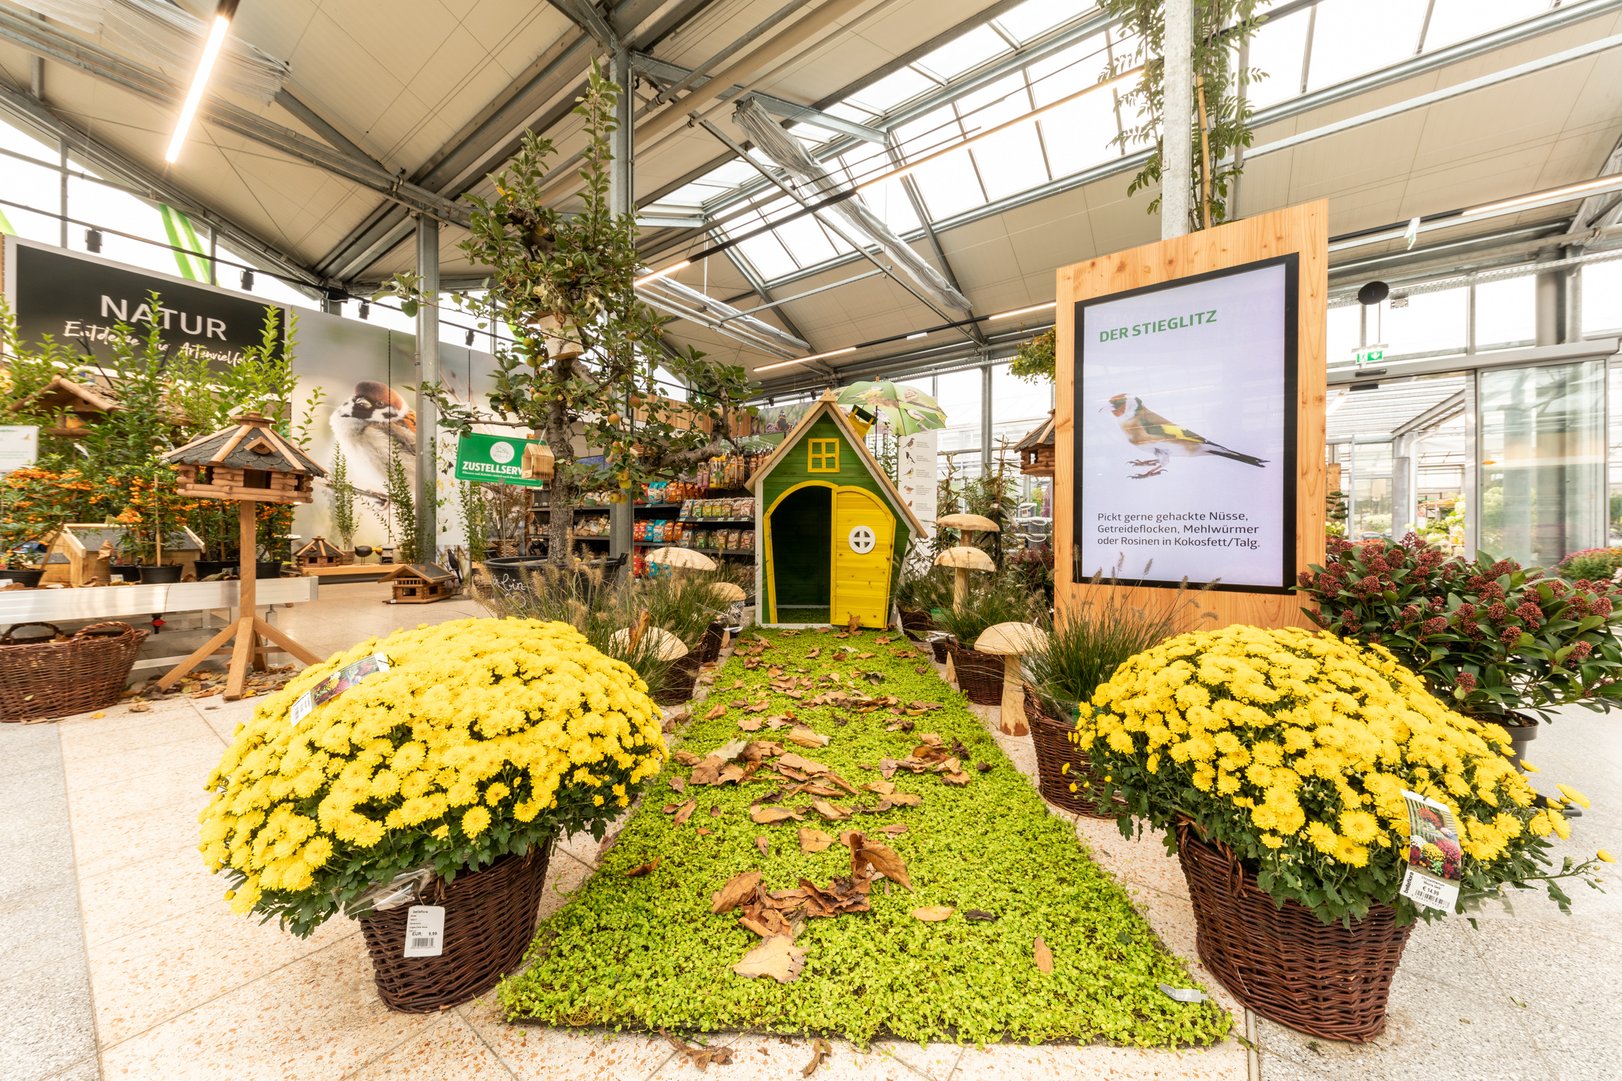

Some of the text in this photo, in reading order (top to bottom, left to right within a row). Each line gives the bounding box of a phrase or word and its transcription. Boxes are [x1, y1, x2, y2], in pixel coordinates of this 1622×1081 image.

[101, 294, 227, 341] NATUR
[1100, 310, 1217, 343] DER STIEGLITZ
[462, 461, 522, 475] ZUSTELLSERV
[1097, 511, 1249, 523] Pickt gerne gehackte Nüsse,
[1097, 524, 1259, 534] Getreideflocken, Mehlwürmer
[1097, 536, 1261, 549] oder Rosinen in Kokosfett/Talg.
